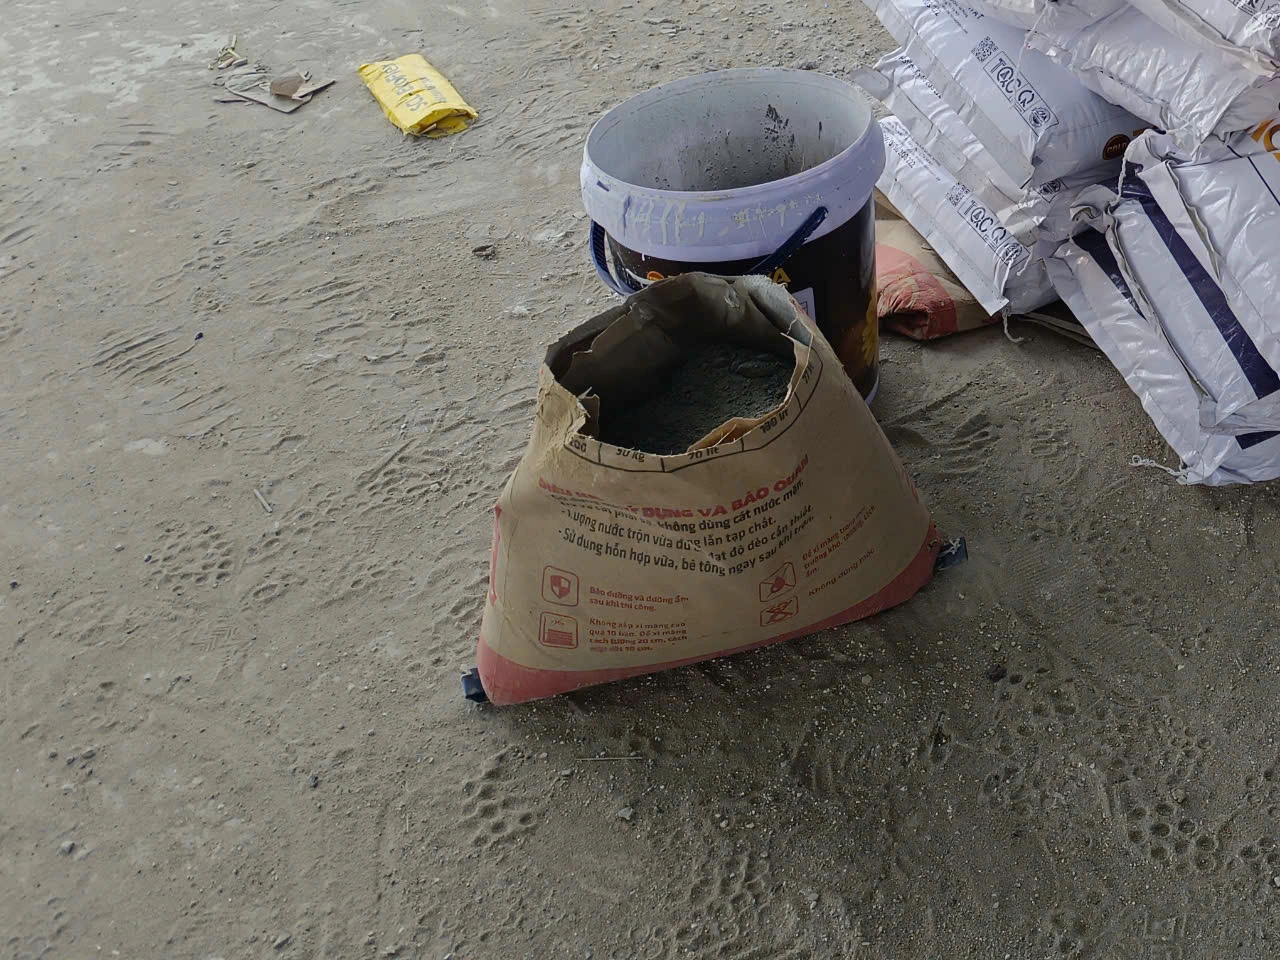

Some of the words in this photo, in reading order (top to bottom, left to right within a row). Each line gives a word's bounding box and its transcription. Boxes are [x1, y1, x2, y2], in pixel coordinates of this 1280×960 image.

[990, 57, 1021, 94] TQC
[964, 199, 993, 232] TQC
[642, 507, 693, 520] DỤNG
[731, 488, 770, 511] BẢO
[699, 519, 731, 530] dùng
[733, 511, 751, 524] cát
[753, 498, 781, 516] nước
[598, 522, 625, 537] nước
[627, 528, 650, 544] trộn
[653, 535, 673, 548] vừa
[730, 546, 744, 558] độ
[747, 537, 768, 552] dẻo
[771, 524, 788, 541] cần
[703, 535, 723, 547] lẫn
[727, 530, 745, 544] tạp
[749, 517, 777, 534] chất.
[563, 528, 576, 543] Sử
[577, 534, 603, 555] dụng
[605, 542, 626, 559] hỗn
[630, 548, 650, 566] hợp
[654, 555, 678, 570] vữa,
[682, 557, 696, 571] bê
[699, 561, 726, 576] tông
[728, 557, 755, 575] ngay
[758, 547, 777, 562] sau
[778, 534, 792, 549] khi
[607, 591, 633, 600] dưỡng
[646, 595, 673, 603] dưỡng
[589, 617, 616, 628] Không
